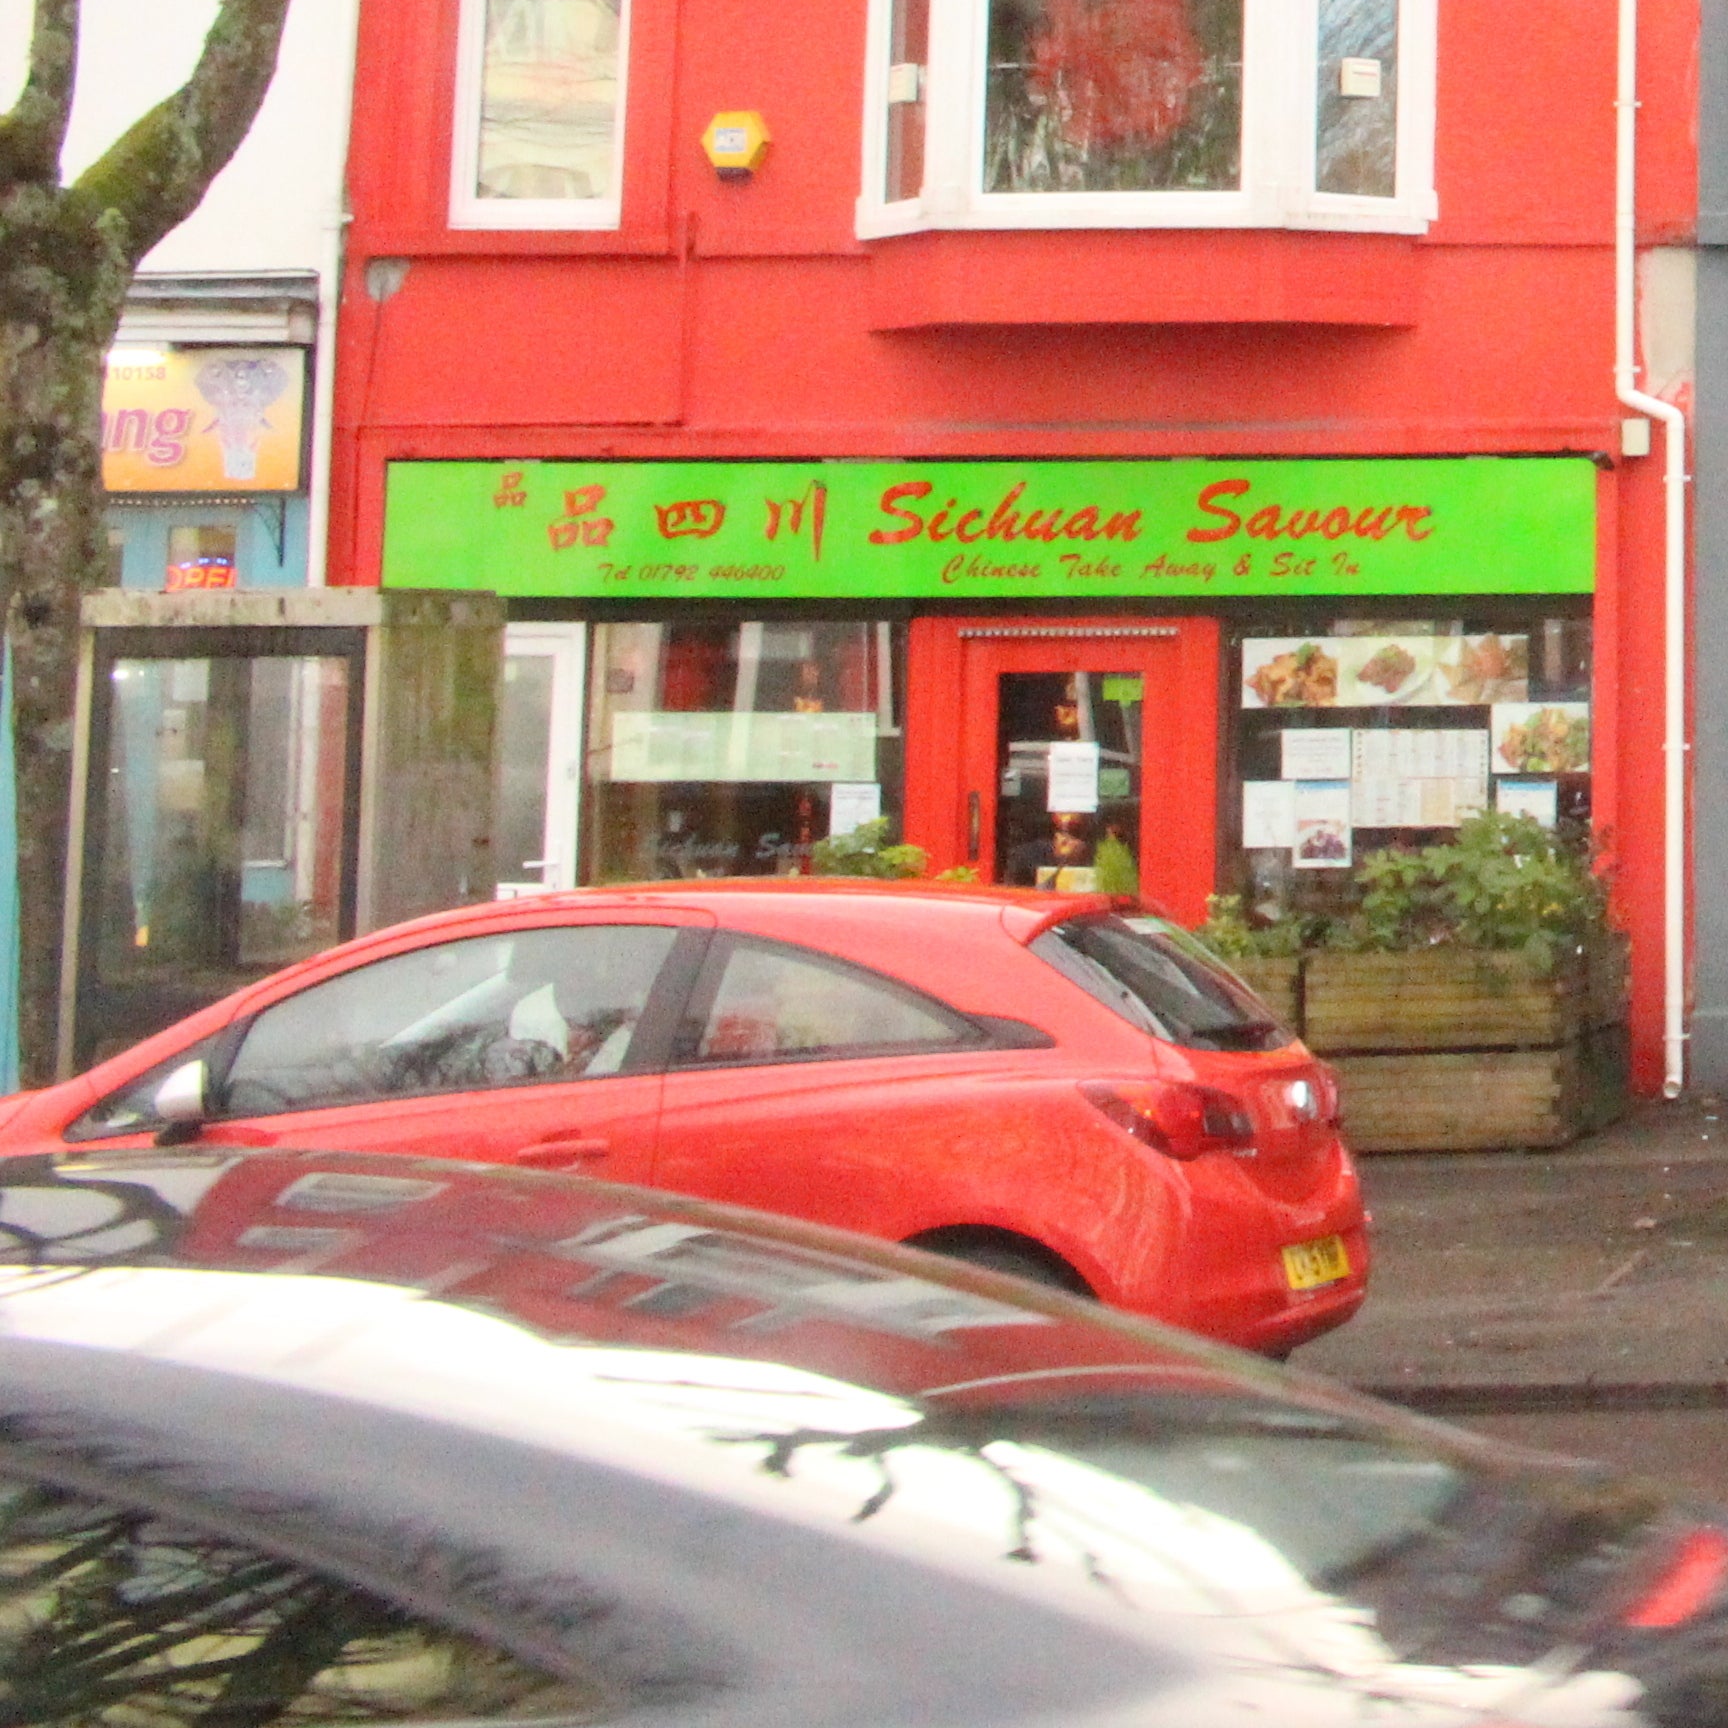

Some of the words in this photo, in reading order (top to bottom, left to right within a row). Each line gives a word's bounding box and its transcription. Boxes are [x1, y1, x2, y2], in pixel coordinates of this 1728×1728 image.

[868, 480, 1143, 545] Sichuan
[1186, 478, 1435, 542] Savour
[638, 563, 700, 582] 01792
[708, 563, 786, 582] 446400
[941, 553, 1041, 584] Chinese
[1058, 553, 1122, 579] Take
[1141, 553, 1216, 583] Away
[1233, 553, 1252, 577] &
[1269, 551, 1317, 577] Sit
[1331, 551, 1361, 576] In
